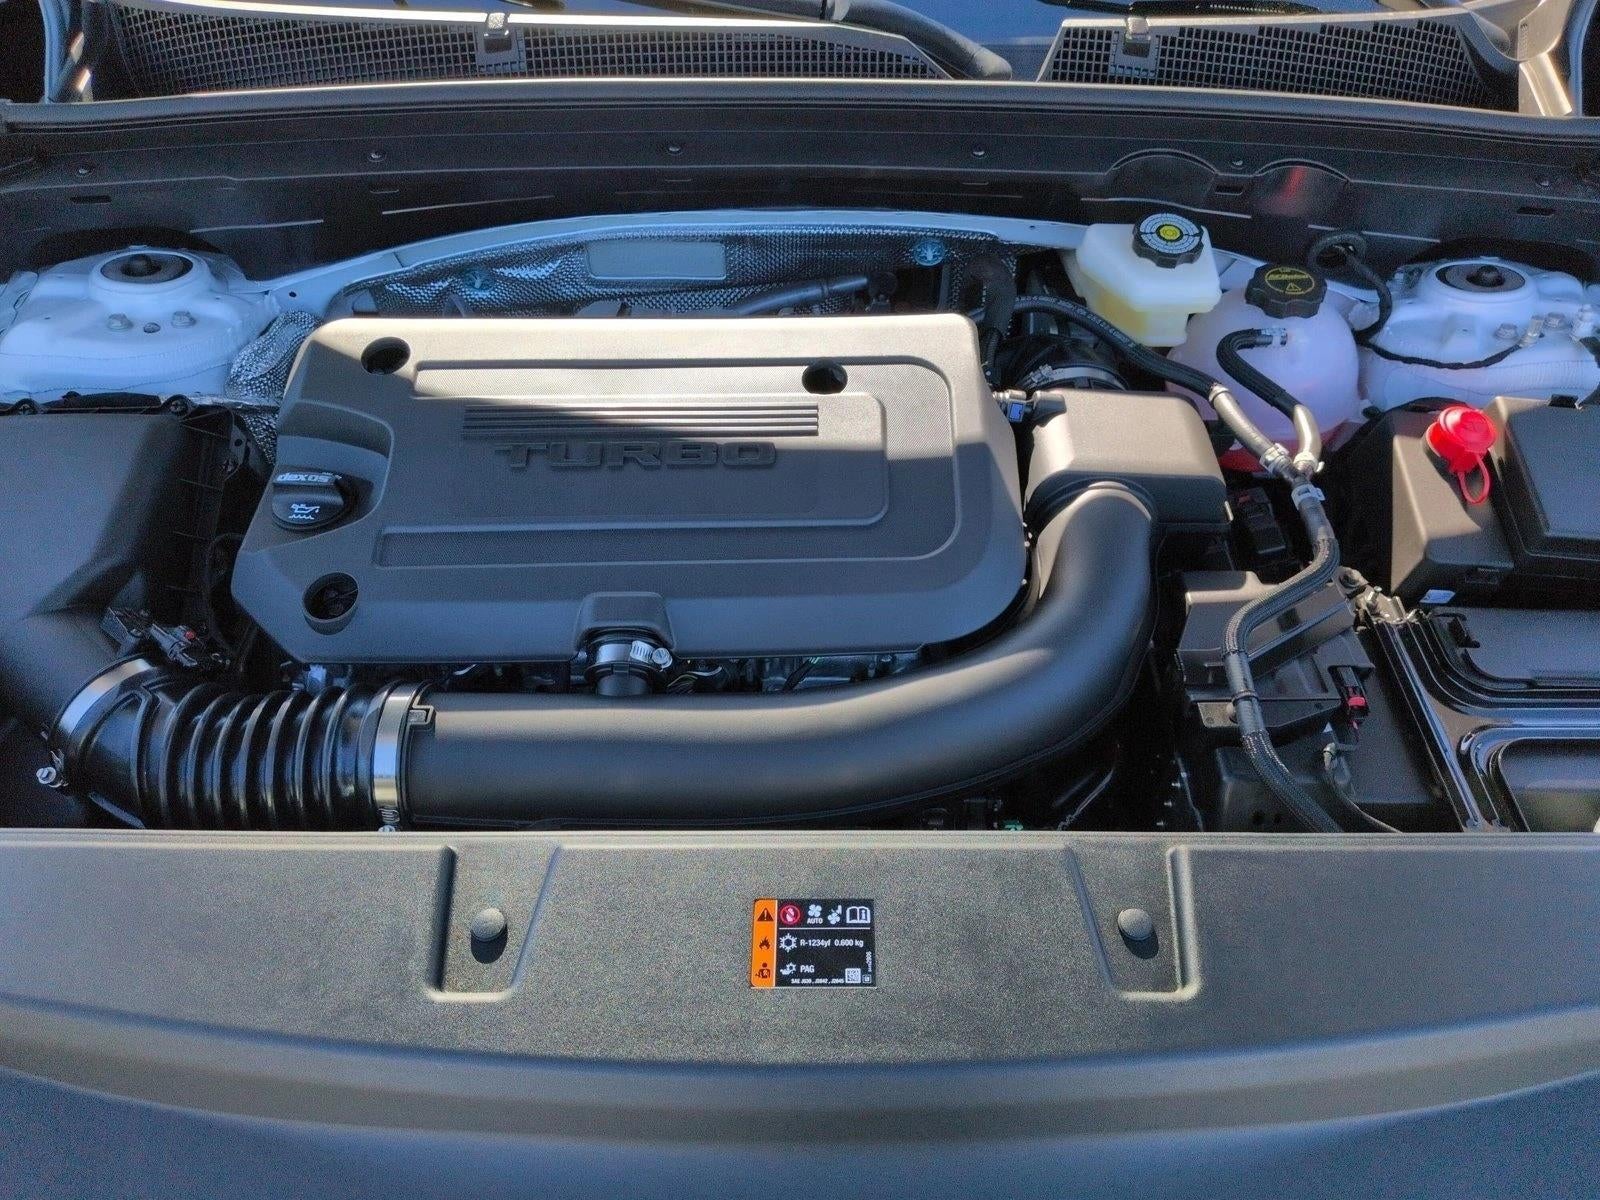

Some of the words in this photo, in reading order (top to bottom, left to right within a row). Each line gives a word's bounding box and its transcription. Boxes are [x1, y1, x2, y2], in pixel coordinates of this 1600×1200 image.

[494, 441, 779, 470] TURBO
[277, 472, 332, 483] dexos
[800, 938, 831, 947] R-1234yf
[855, 938, 864, 947] kg
[800, 965, 815, 973] PAG
